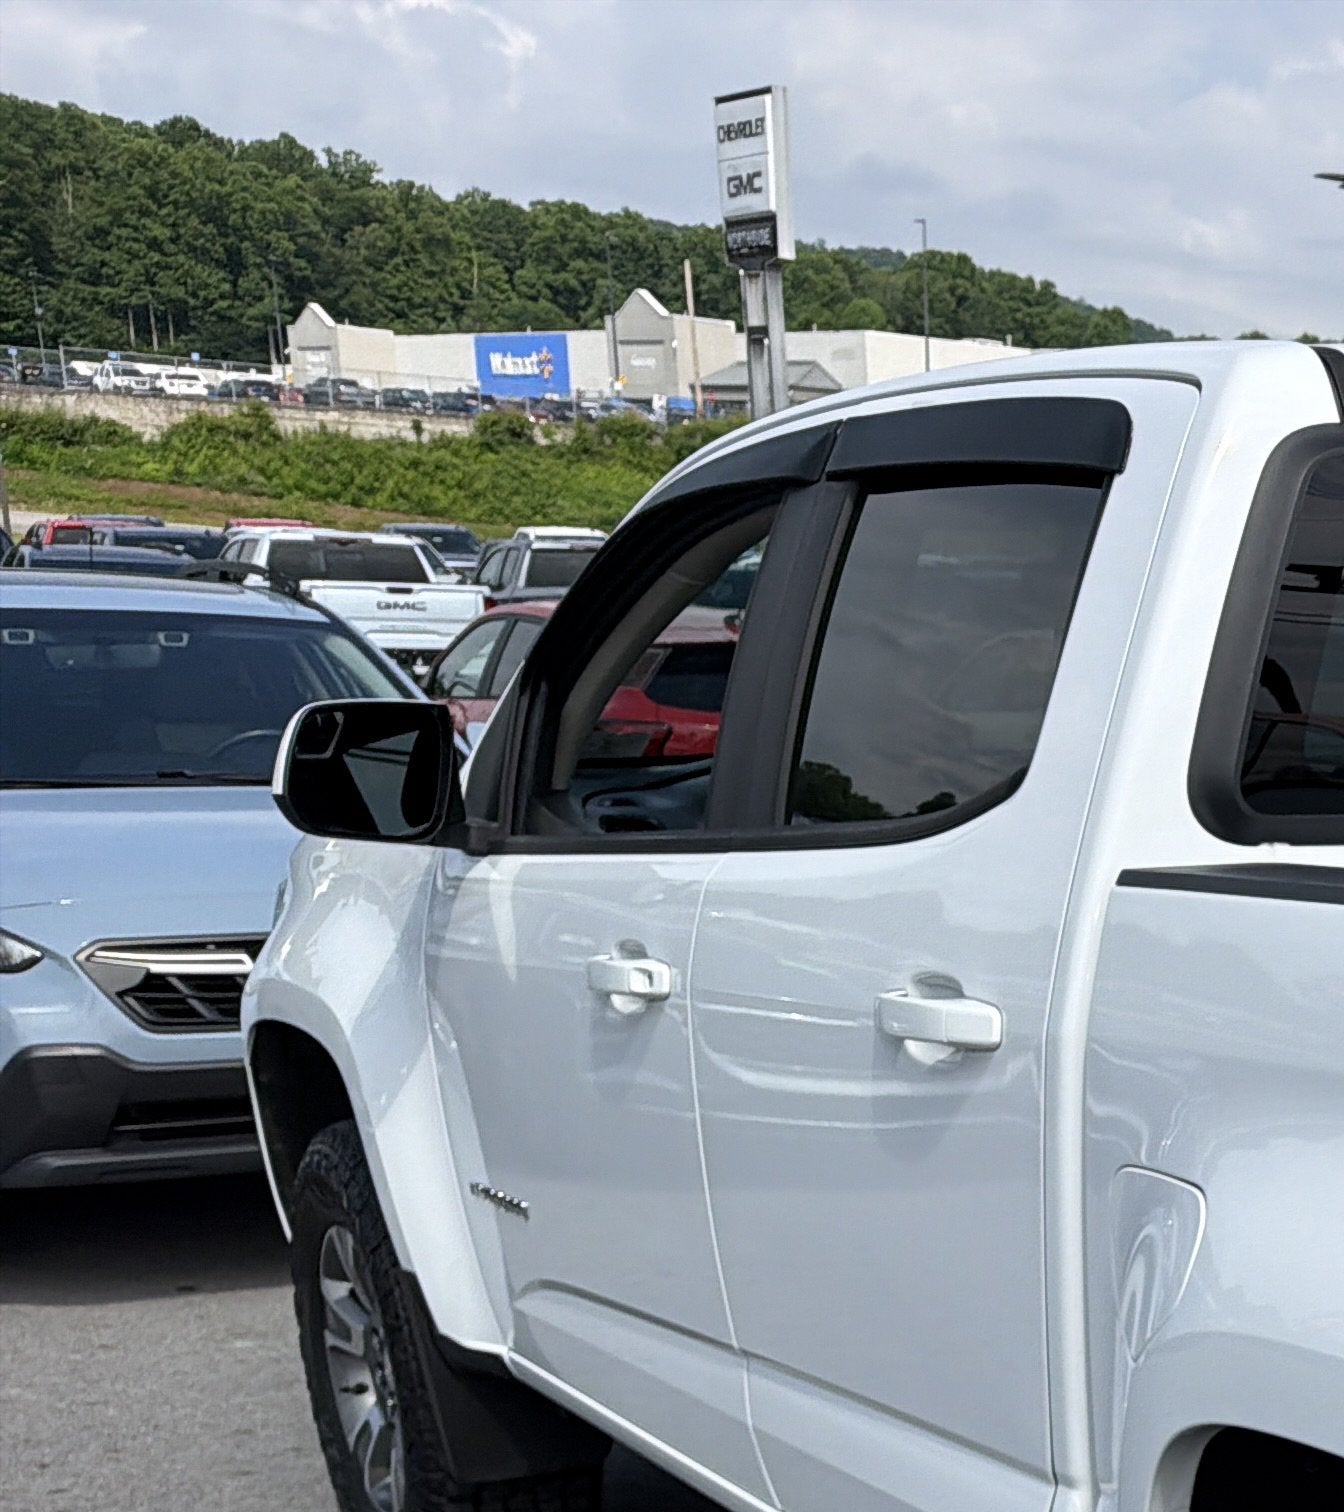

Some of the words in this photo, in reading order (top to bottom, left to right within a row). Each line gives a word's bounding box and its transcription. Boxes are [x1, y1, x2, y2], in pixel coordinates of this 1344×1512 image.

[717, 117, 766, 143] CHEVROLET
[727, 171, 763, 198] GMC
[376, 601, 427, 612] GMC
